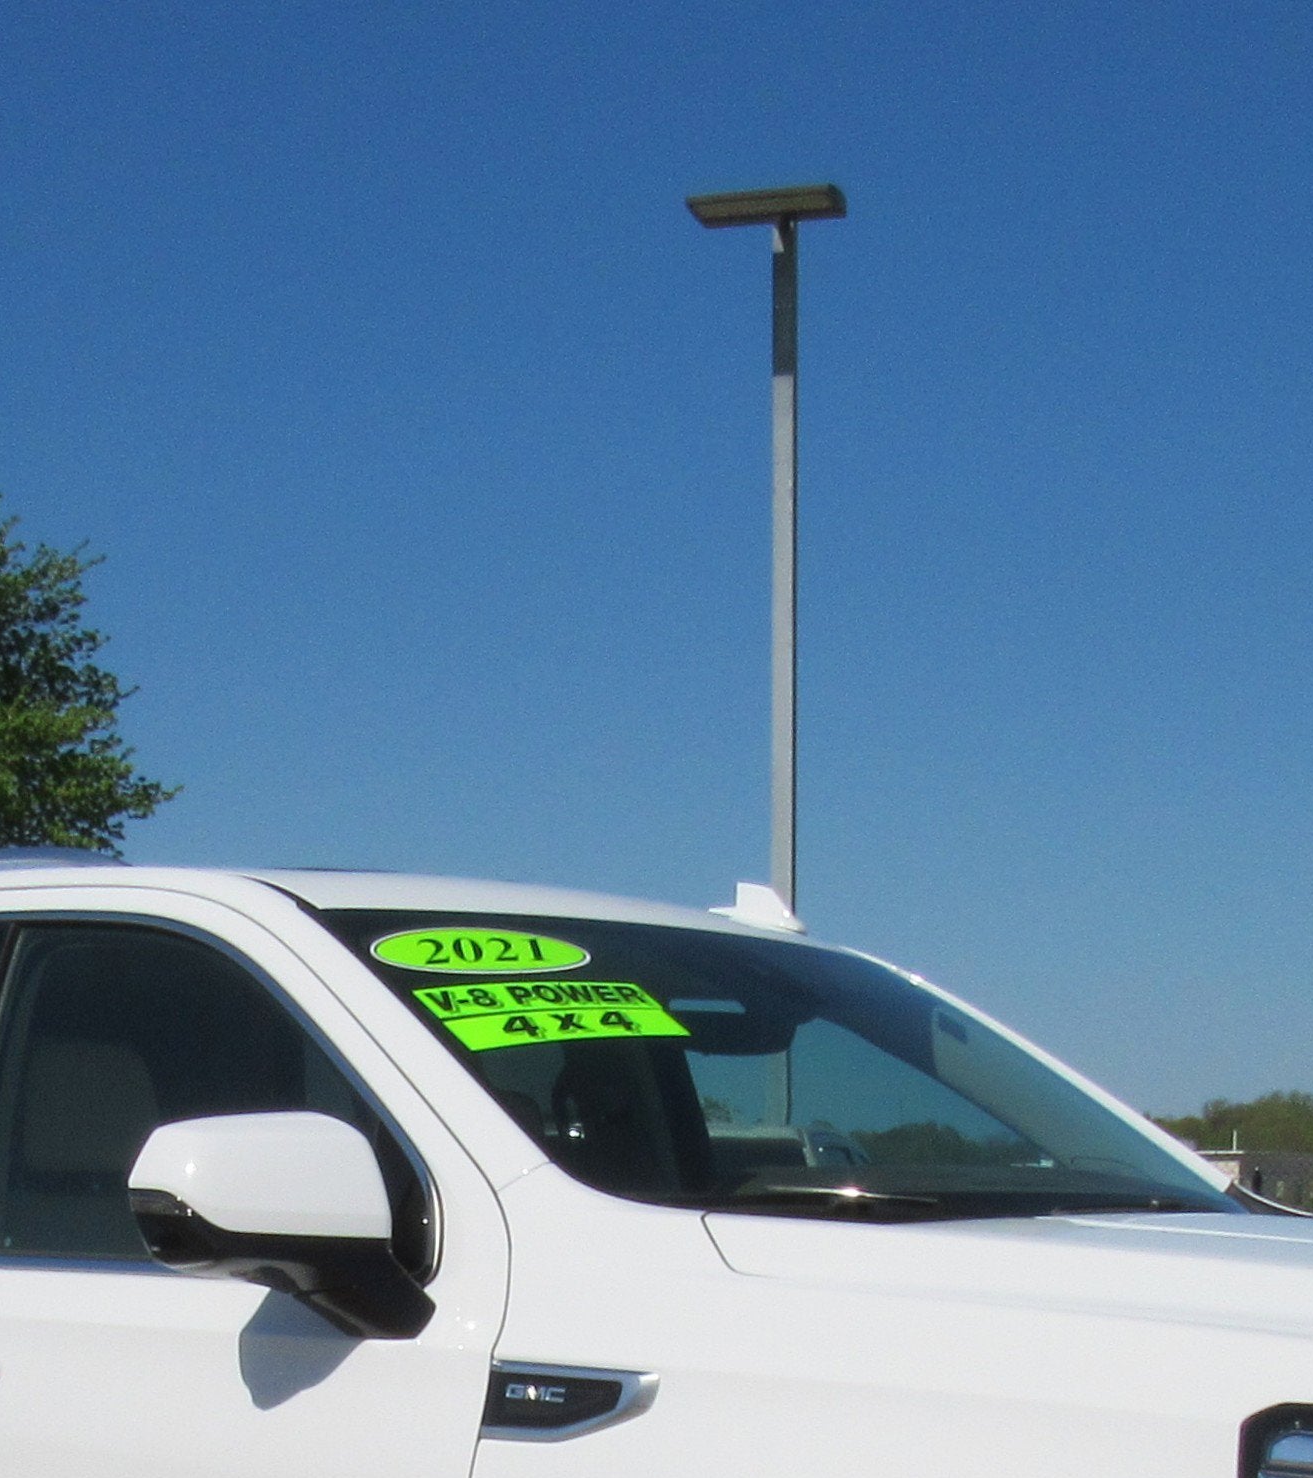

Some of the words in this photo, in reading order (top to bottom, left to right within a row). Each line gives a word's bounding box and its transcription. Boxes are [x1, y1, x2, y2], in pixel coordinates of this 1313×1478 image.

[417, 936, 547, 965] 2021
[425, 988, 500, 1013] V-8
[506, 983, 650, 1007] POWER
[505, 1383, 566, 1402] GMC
